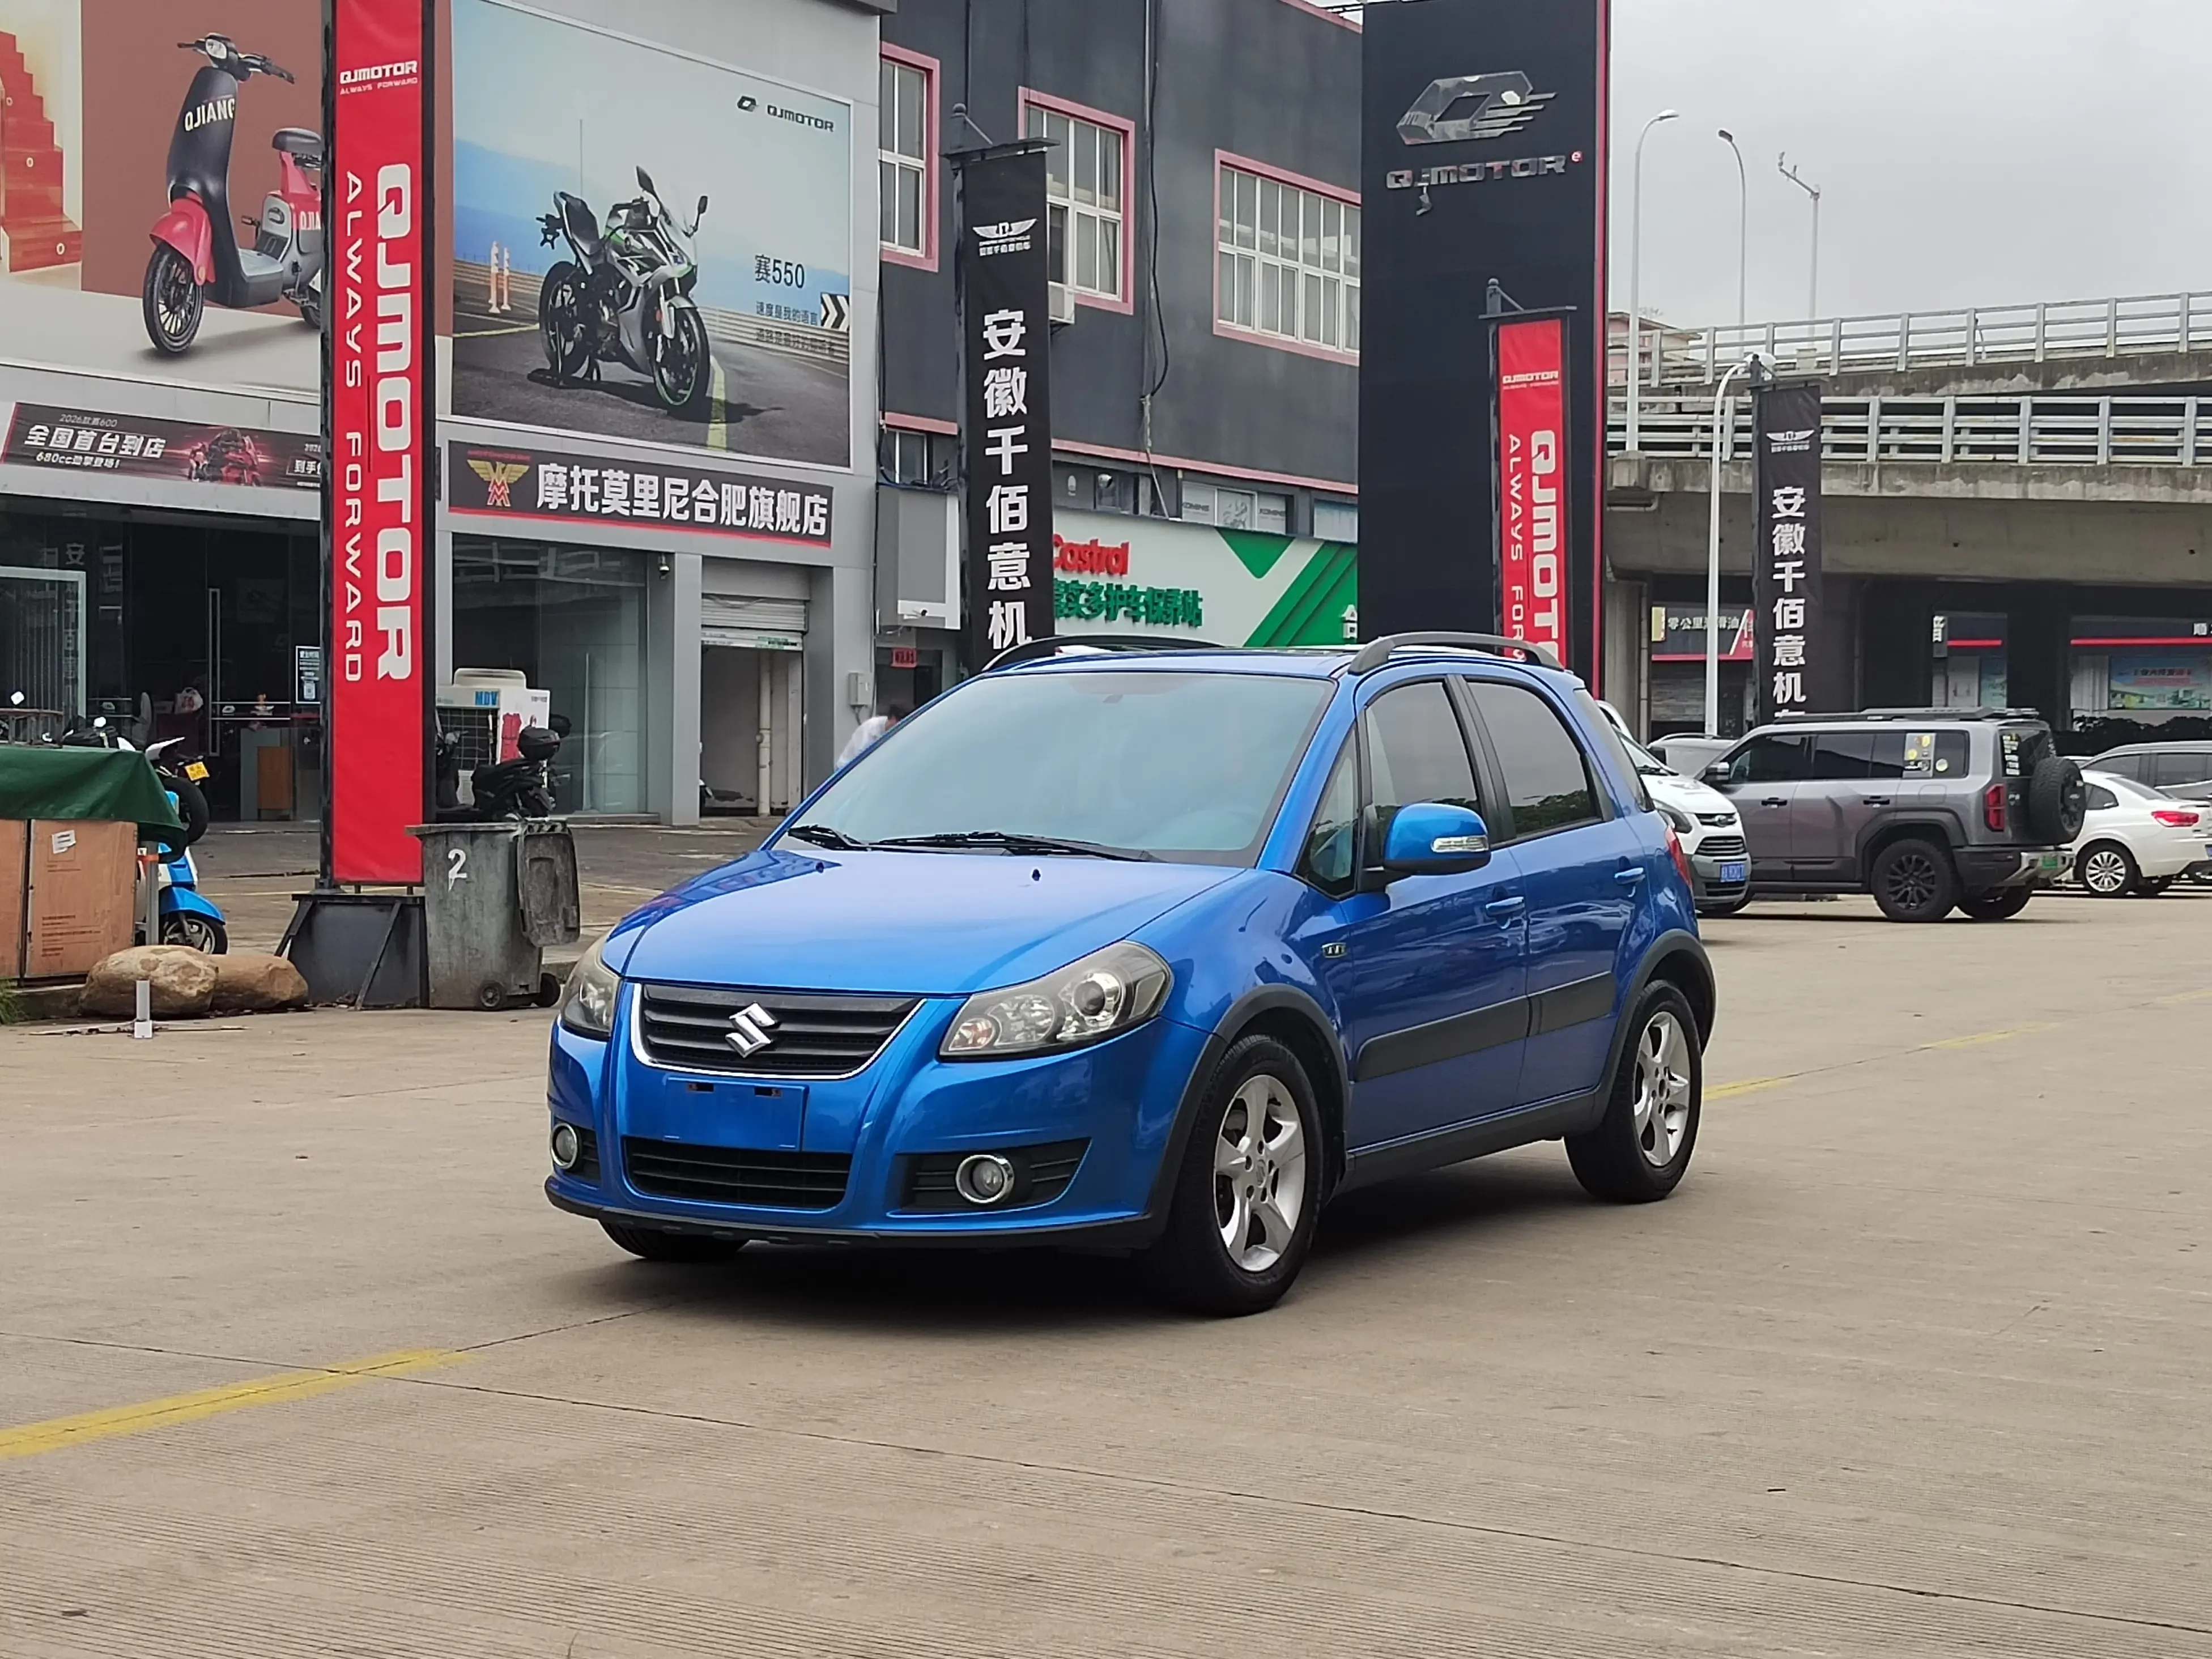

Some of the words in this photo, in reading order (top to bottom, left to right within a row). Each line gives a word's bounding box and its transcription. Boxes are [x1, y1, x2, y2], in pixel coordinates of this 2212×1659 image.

[340, 60, 418, 84] QJMOTOR
[340, 84, 373, 95] ALWAYS
[377, 77, 418, 90] FORWARD
[767, 104, 834, 132] QJMOTOR
[344, 171, 363, 388] ALWAYS
[755, 254, 805, 289] 赛550
[24, 425, 167, 458] 全国首台到店
[376, 163, 412, 680] QJMOTOR
[537, 463, 829, 536] 摩托莫里尼合肥旗舰店
[982, 308, 1032, 650] 安徽千佰意机
[1508, 433, 1522, 561] ALWAYS
[344, 431, 363, 681] FORWARD
[1667, 615, 1739, 630] 零公里滑油
[1772, 486, 1806, 718] 安徽千佰意机
[448, 849, 467, 891] 2
